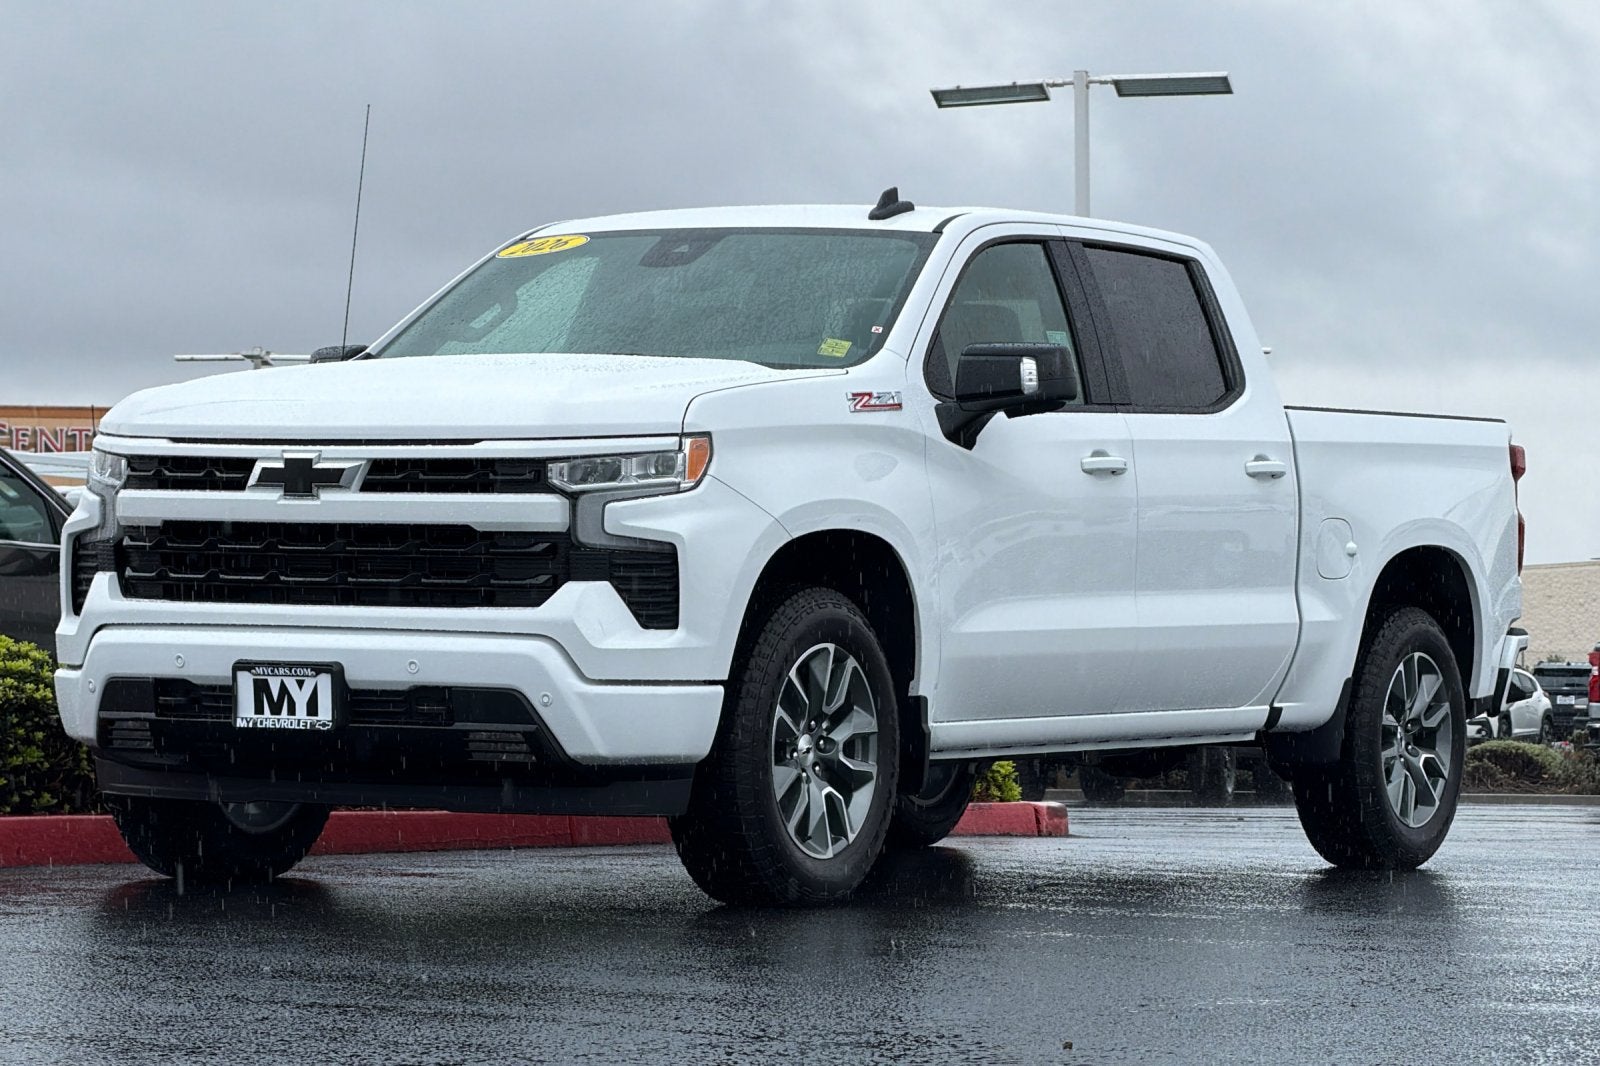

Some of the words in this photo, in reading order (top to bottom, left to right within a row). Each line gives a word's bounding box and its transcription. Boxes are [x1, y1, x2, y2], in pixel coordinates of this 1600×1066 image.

[846, 391, 903, 413] Z71
[254, 666, 313, 677] MYCARS.COM
[252, 677, 320, 717] MY
[236, 717, 255, 728] MY
[257, 717, 312, 730] CHEVROLET
